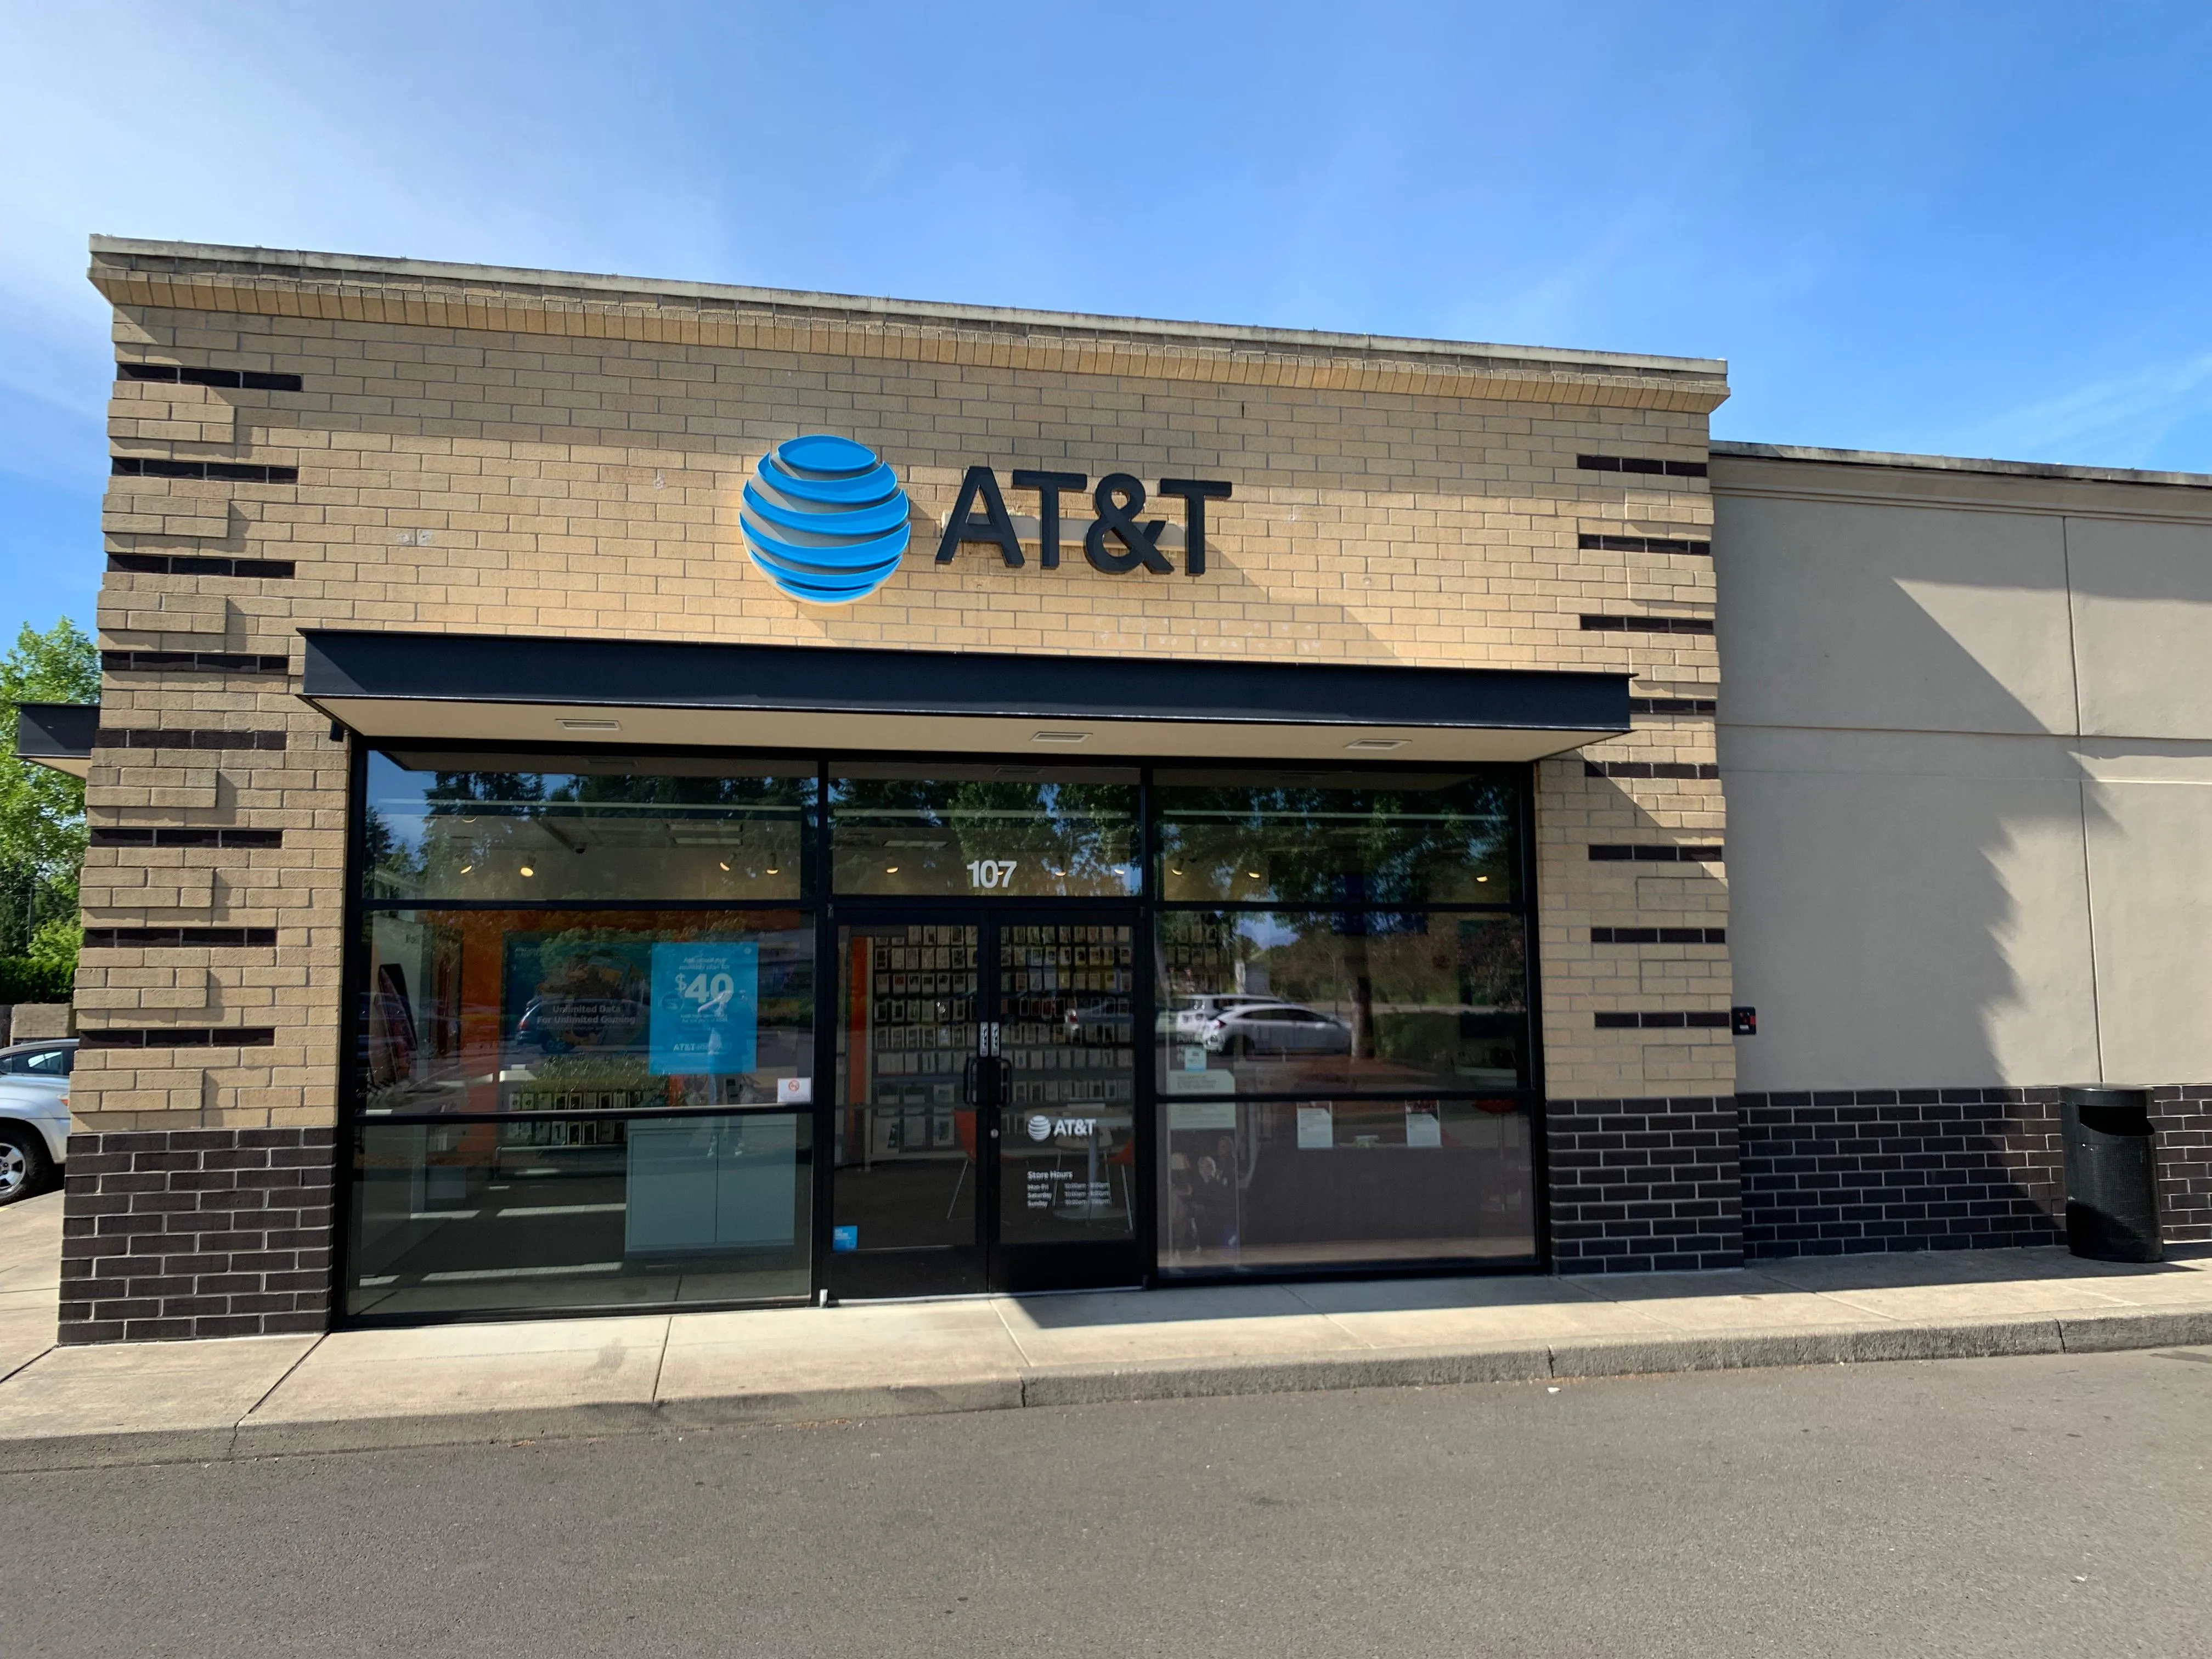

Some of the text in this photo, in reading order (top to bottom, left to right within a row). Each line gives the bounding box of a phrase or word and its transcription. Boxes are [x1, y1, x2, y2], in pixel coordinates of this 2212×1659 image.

[935, 465, 1233, 577] AT&T
[967, 860, 1017, 889] 107
[675, 973, 734, 1003] $40
[552, 1005, 621, 1014] Unlimited Data
[554, 1015, 599, 1024] Unlimited
[601, 1015, 636, 1025] Gaming
[1053, 1119, 1097, 1137] AT&T
[1027, 1170, 1073, 1180] Store Hours
[1027, 1193, 1052, 1201] Saturday
